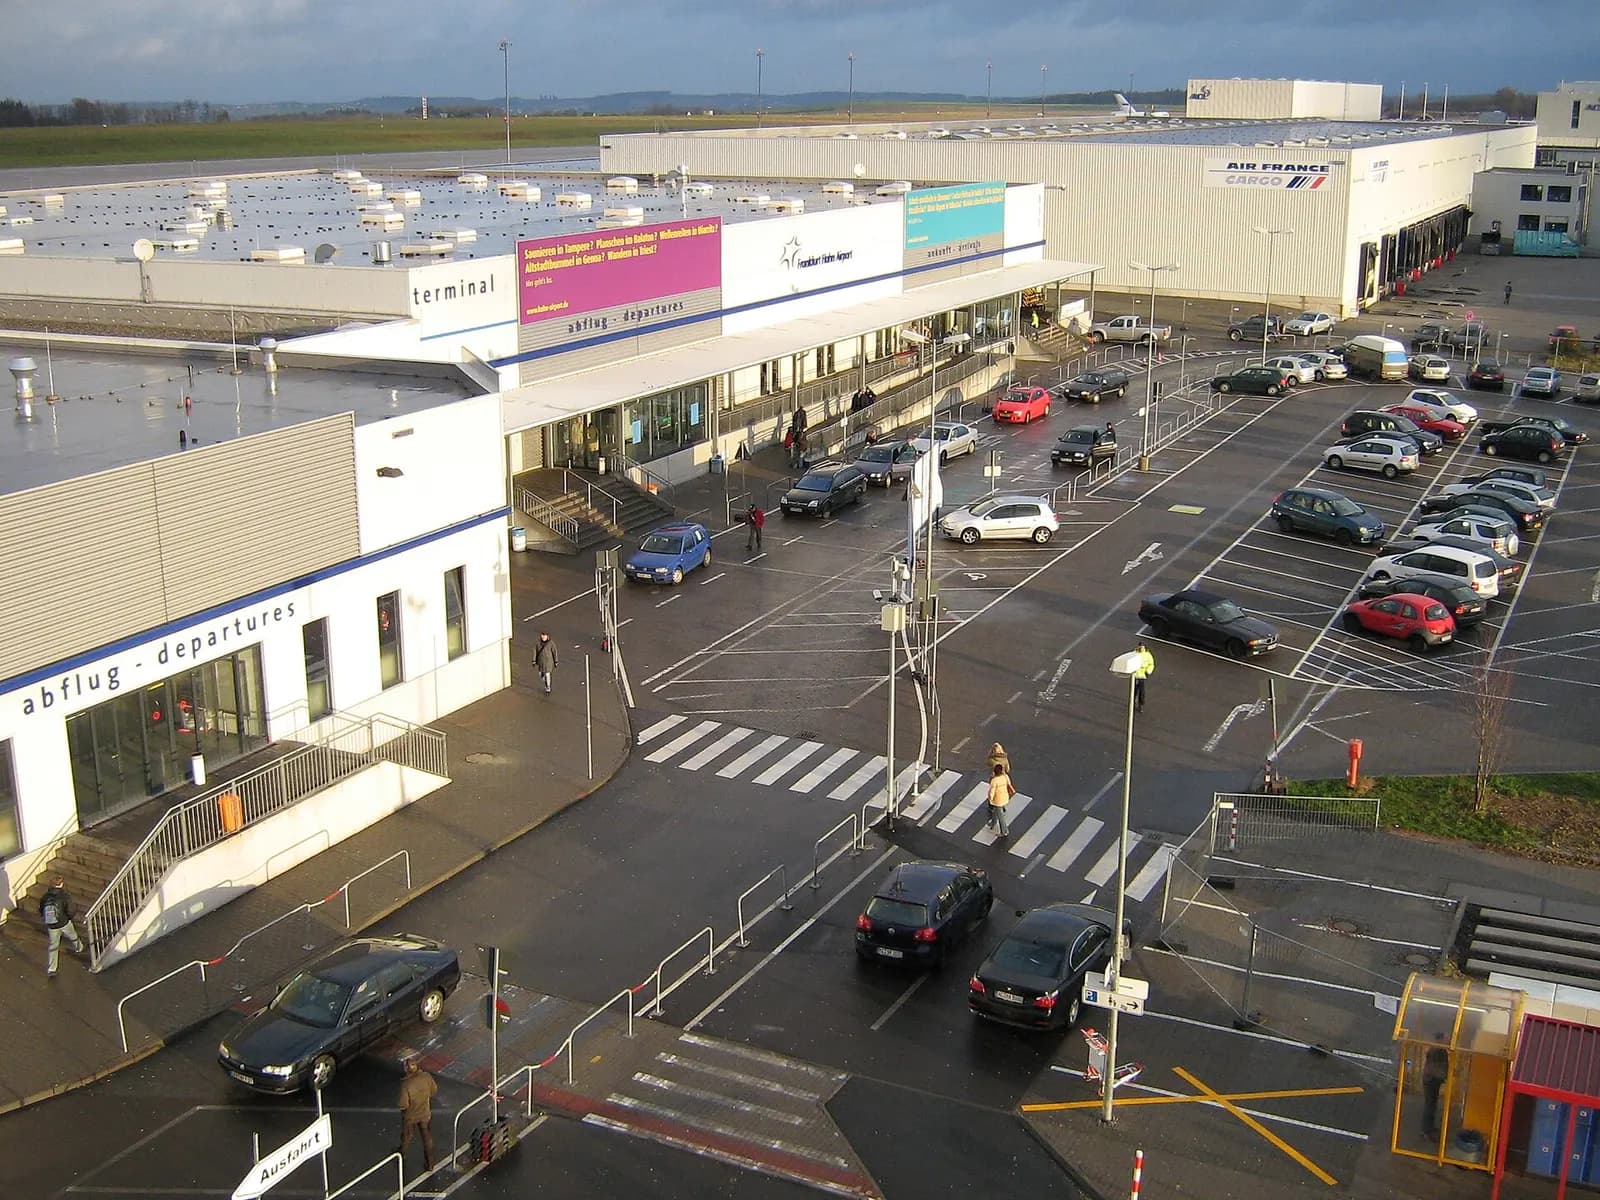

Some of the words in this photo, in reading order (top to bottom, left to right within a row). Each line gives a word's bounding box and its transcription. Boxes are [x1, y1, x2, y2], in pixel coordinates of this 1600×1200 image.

[1225, 175, 1282, 186] CARGO
[1226, 162, 1256, 170] AIR
[1262, 163, 1329, 173] FRANCE
[525, 246, 556, 260] Saunieren
[557, 244, 564, 255] in
[565, 240, 594, 255] Tampere?
[596, 236, 625, 250] Planschen
[575, 254, 582, 266] in
[632, 246, 639, 258] in
[413, 273, 494, 306] terminal
[568, 316, 609, 334] abflug
[623, 301, 684, 323] departures
[23, 666, 120, 716] abflug
[157, 601, 296, 666] departures
[261, 1131, 321, 1184] Ausfahrt
